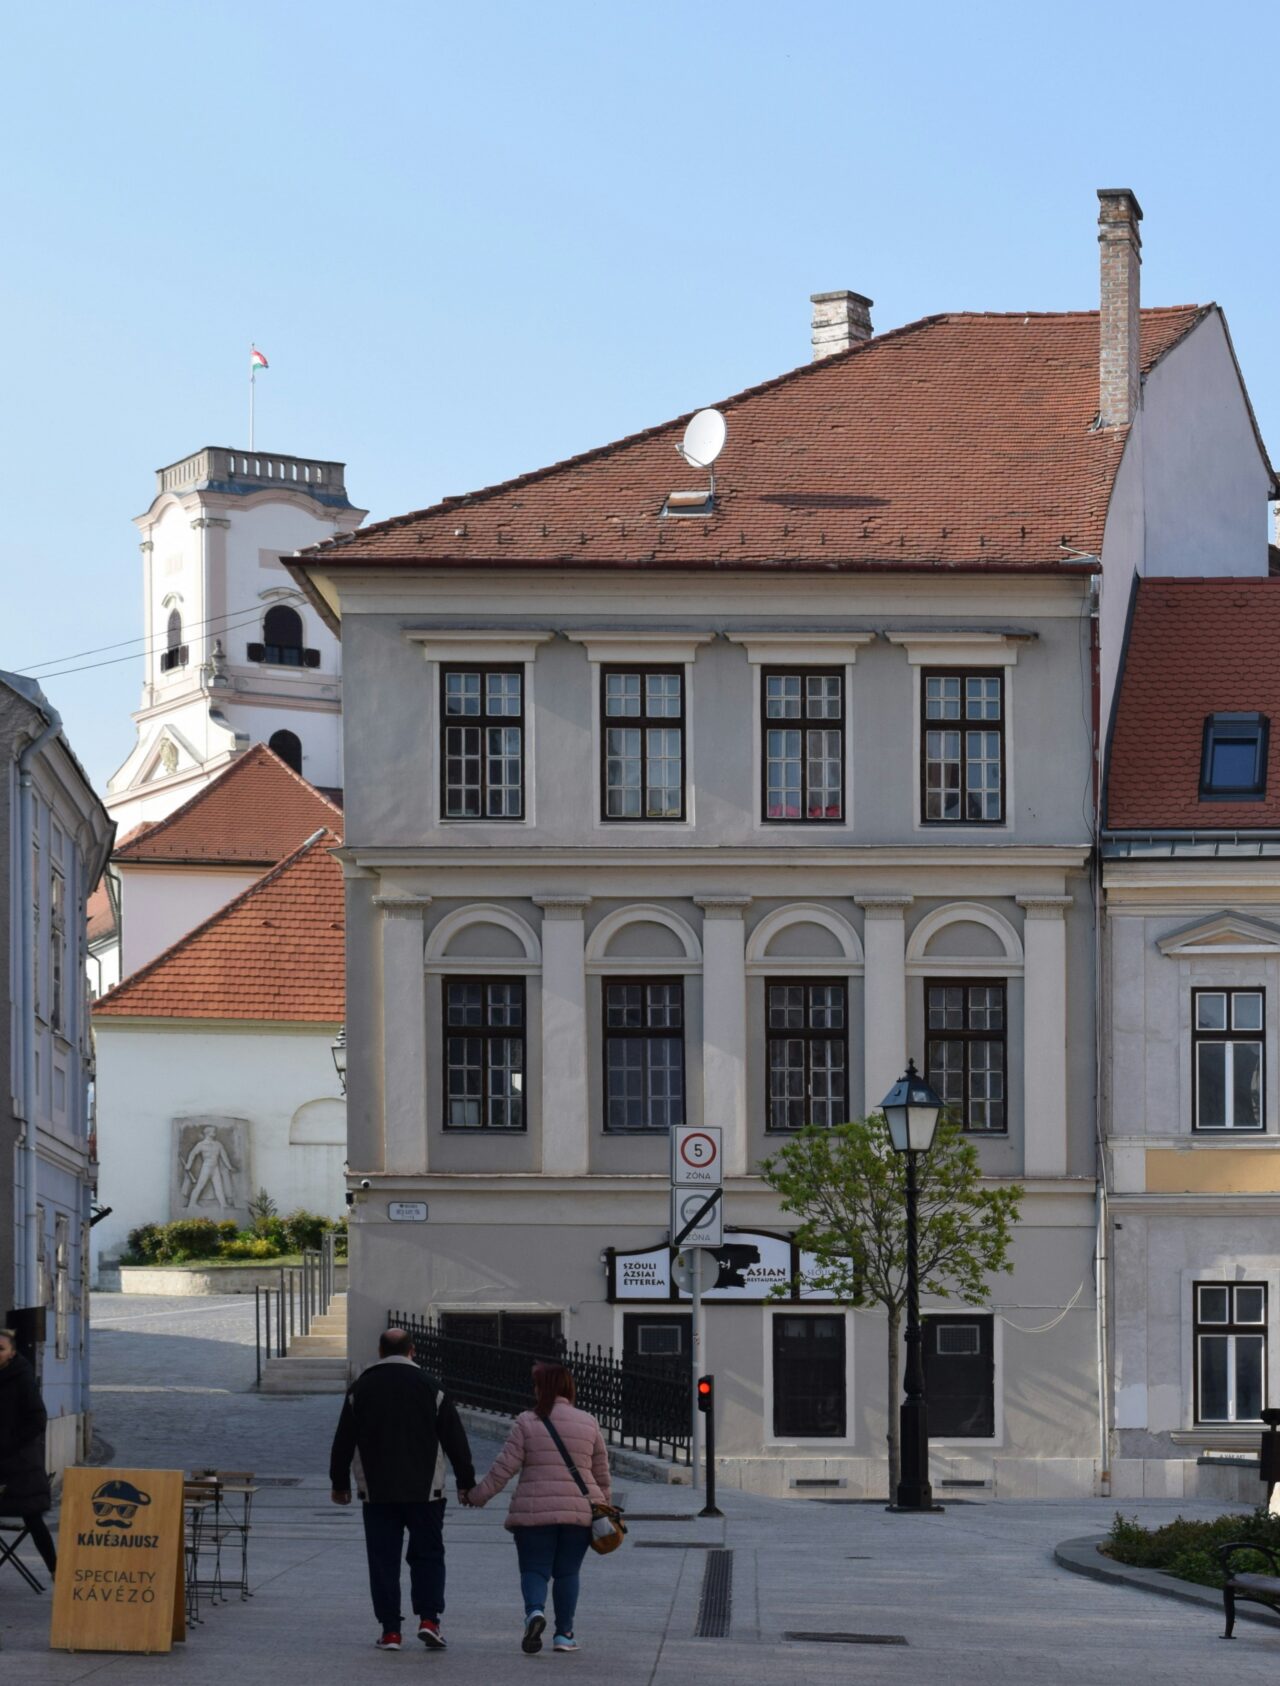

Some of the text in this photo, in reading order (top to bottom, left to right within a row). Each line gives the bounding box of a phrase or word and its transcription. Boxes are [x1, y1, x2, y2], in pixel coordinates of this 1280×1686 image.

[694, 1143, 703, 1157] 5
[686, 1171, 711, 1180] ZÓNA
[747, 1267, 786, 1276] ASIAN
[77, 1529, 160, 1548] KÁVÉBAJUSZ
[74, 1569, 156, 1584] SPECIALTY
[72, 1584, 155, 1603] KÁVÉZÓ
